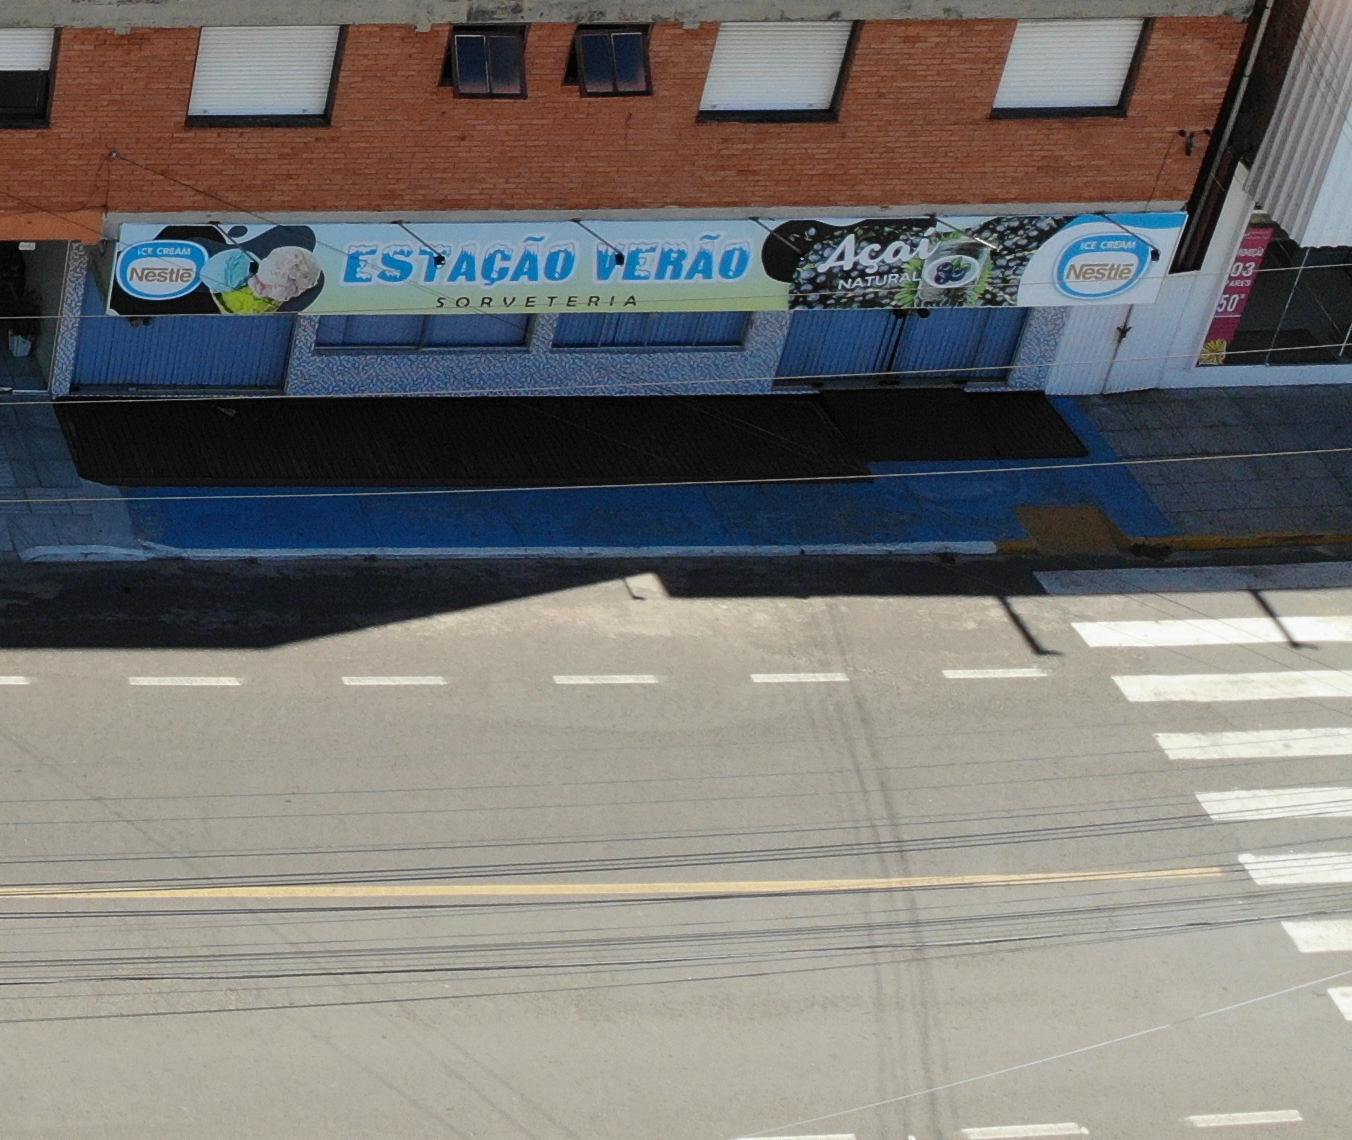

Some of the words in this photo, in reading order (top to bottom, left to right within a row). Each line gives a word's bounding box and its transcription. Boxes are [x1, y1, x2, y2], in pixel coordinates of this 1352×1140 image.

[137, 247, 154, 255] ICE
[156, 247, 191, 255] CREAM
[1080, 241, 1097, 251] ICE
[1100, 241, 1137, 250] CREAM
[342, 236, 576, 285] ESTAÇÃO
[597, 234, 750, 281] VERÃO
[838, 272, 923, 291] NATURAL
[436, 295, 638, 308] SORVETERIA
